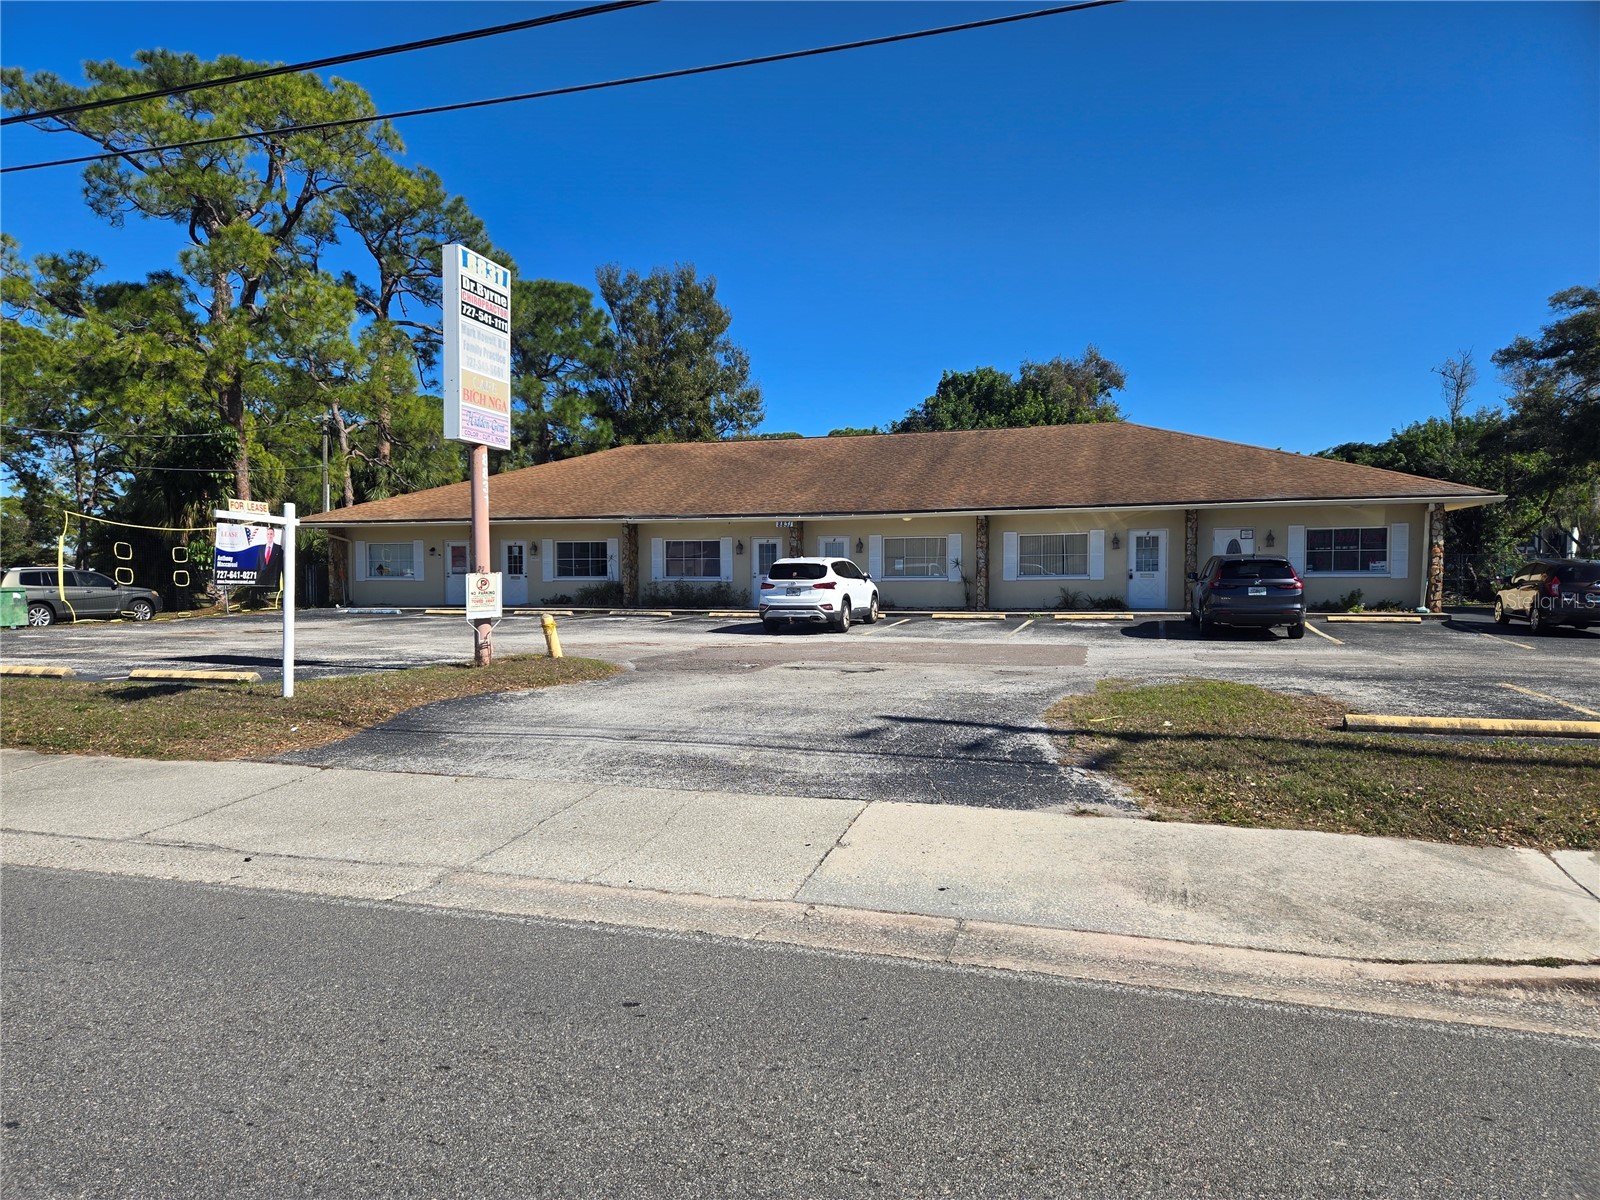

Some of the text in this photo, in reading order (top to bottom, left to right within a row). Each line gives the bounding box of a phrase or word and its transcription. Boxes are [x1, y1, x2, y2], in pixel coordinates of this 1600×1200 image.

[467, 252, 503, 286] 8831
[462, 290, 508, 319] CHIROPRACTOR
[462, 304, 508, 331] 727-541-1111
[488, 396, 507, 413] NGA
[464, 429, 479, 438] COLOR
[230, 500, 267, 513] FOR LEASE
